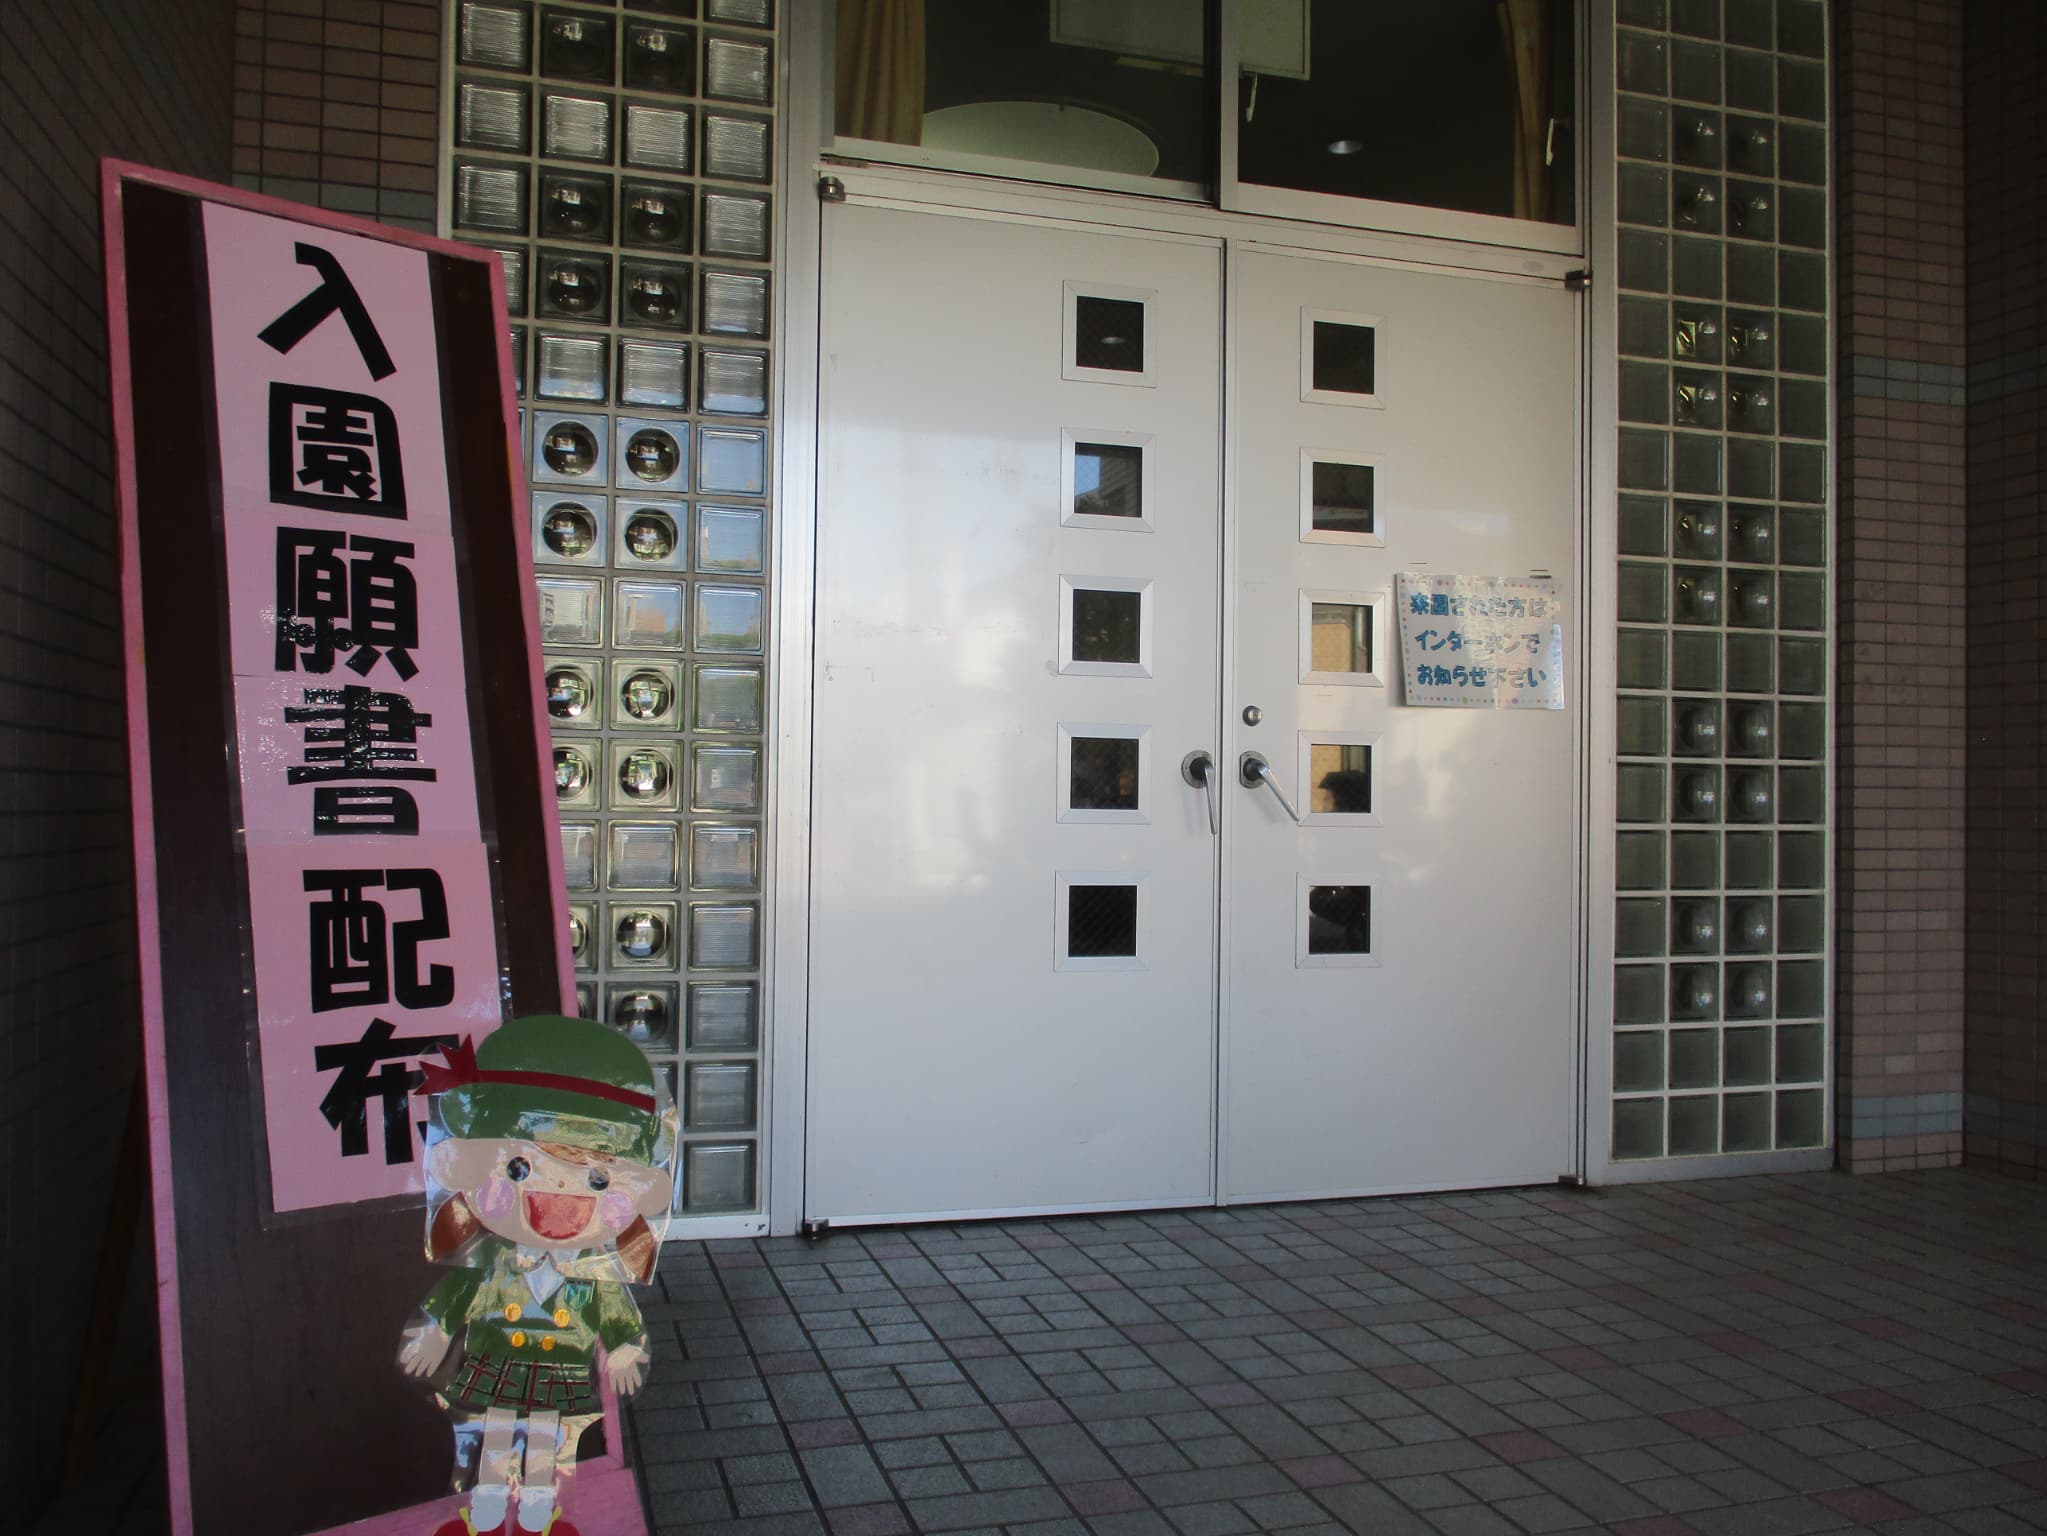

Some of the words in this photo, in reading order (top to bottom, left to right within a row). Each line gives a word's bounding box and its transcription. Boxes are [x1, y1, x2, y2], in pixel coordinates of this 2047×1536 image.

[1410, 593, 1547, 617] 来園された方は
[1417, 664, 1547, 688] お知らせ下さい
[257, 241, 459, 1165] 入園願書配布
